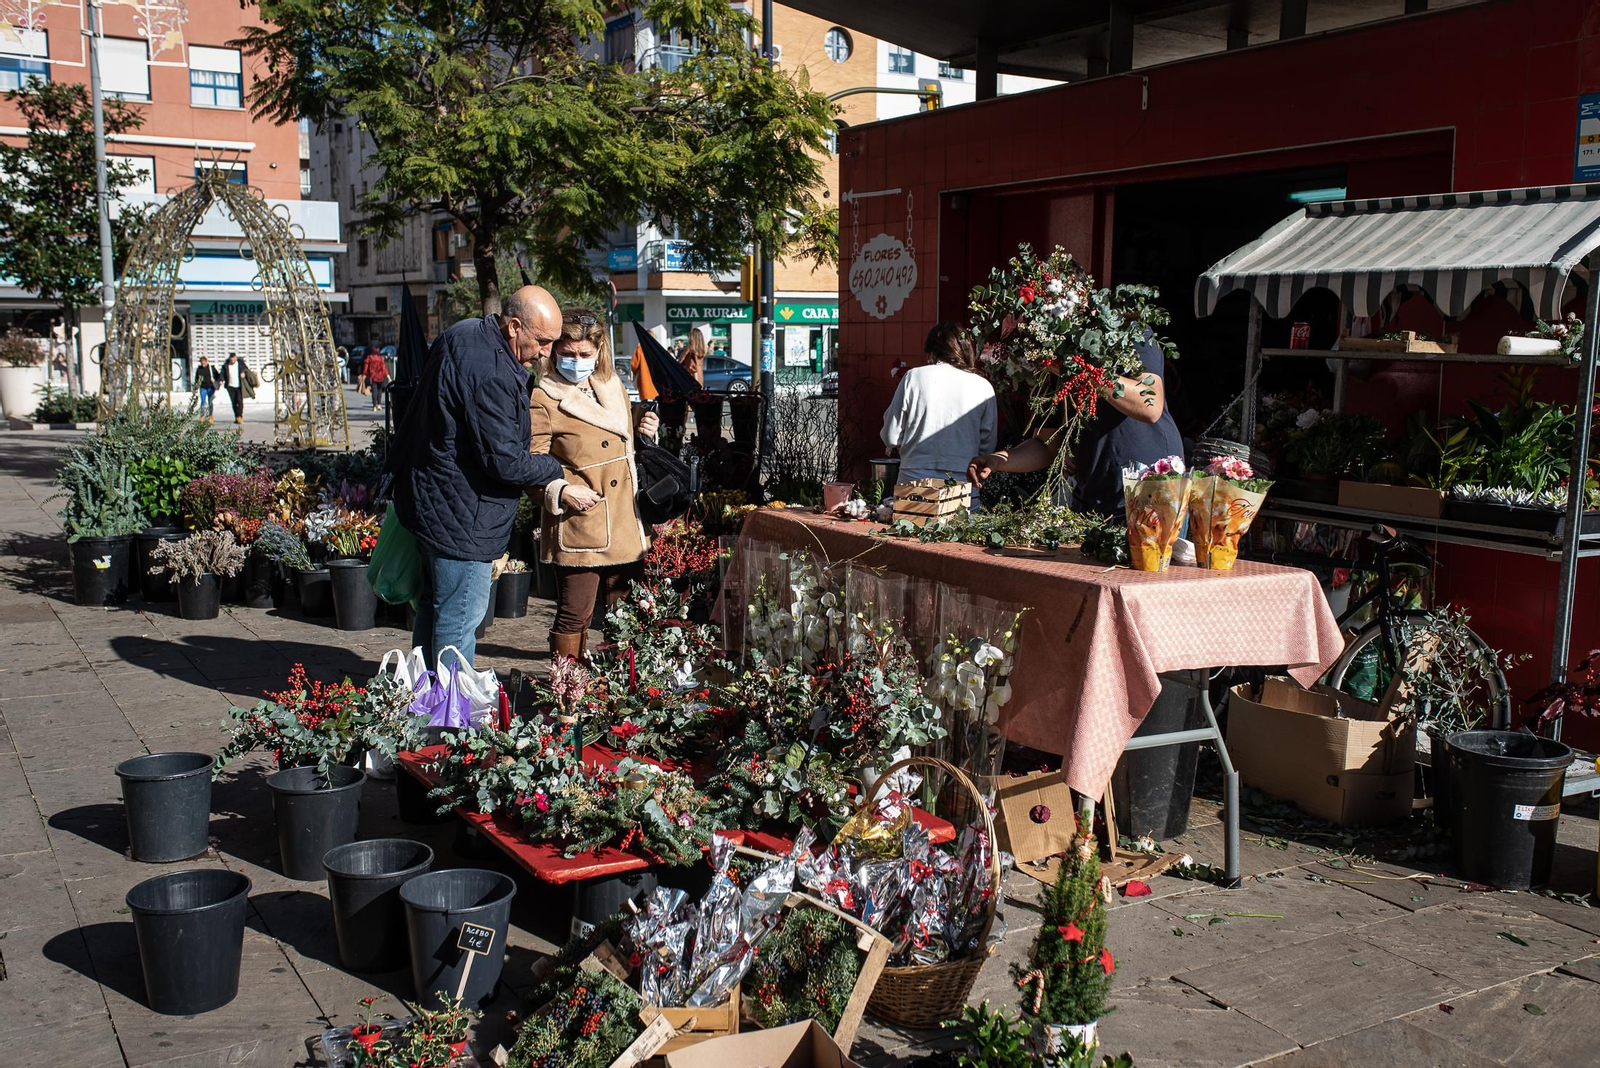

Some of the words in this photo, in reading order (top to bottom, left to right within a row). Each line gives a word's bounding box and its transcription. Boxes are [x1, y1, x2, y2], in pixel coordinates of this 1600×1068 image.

[864, 247, 902, 263] FLORES
[208, 301, 264, 315] Aromas
[668, 307, 700, 319] CAJA
[703, 307, 748, 319] RURAL
[802, 307, 830, 320] CAJA
[466, 926, 490, 938] ACEBO
[469, 936, 483, 948] 4€
